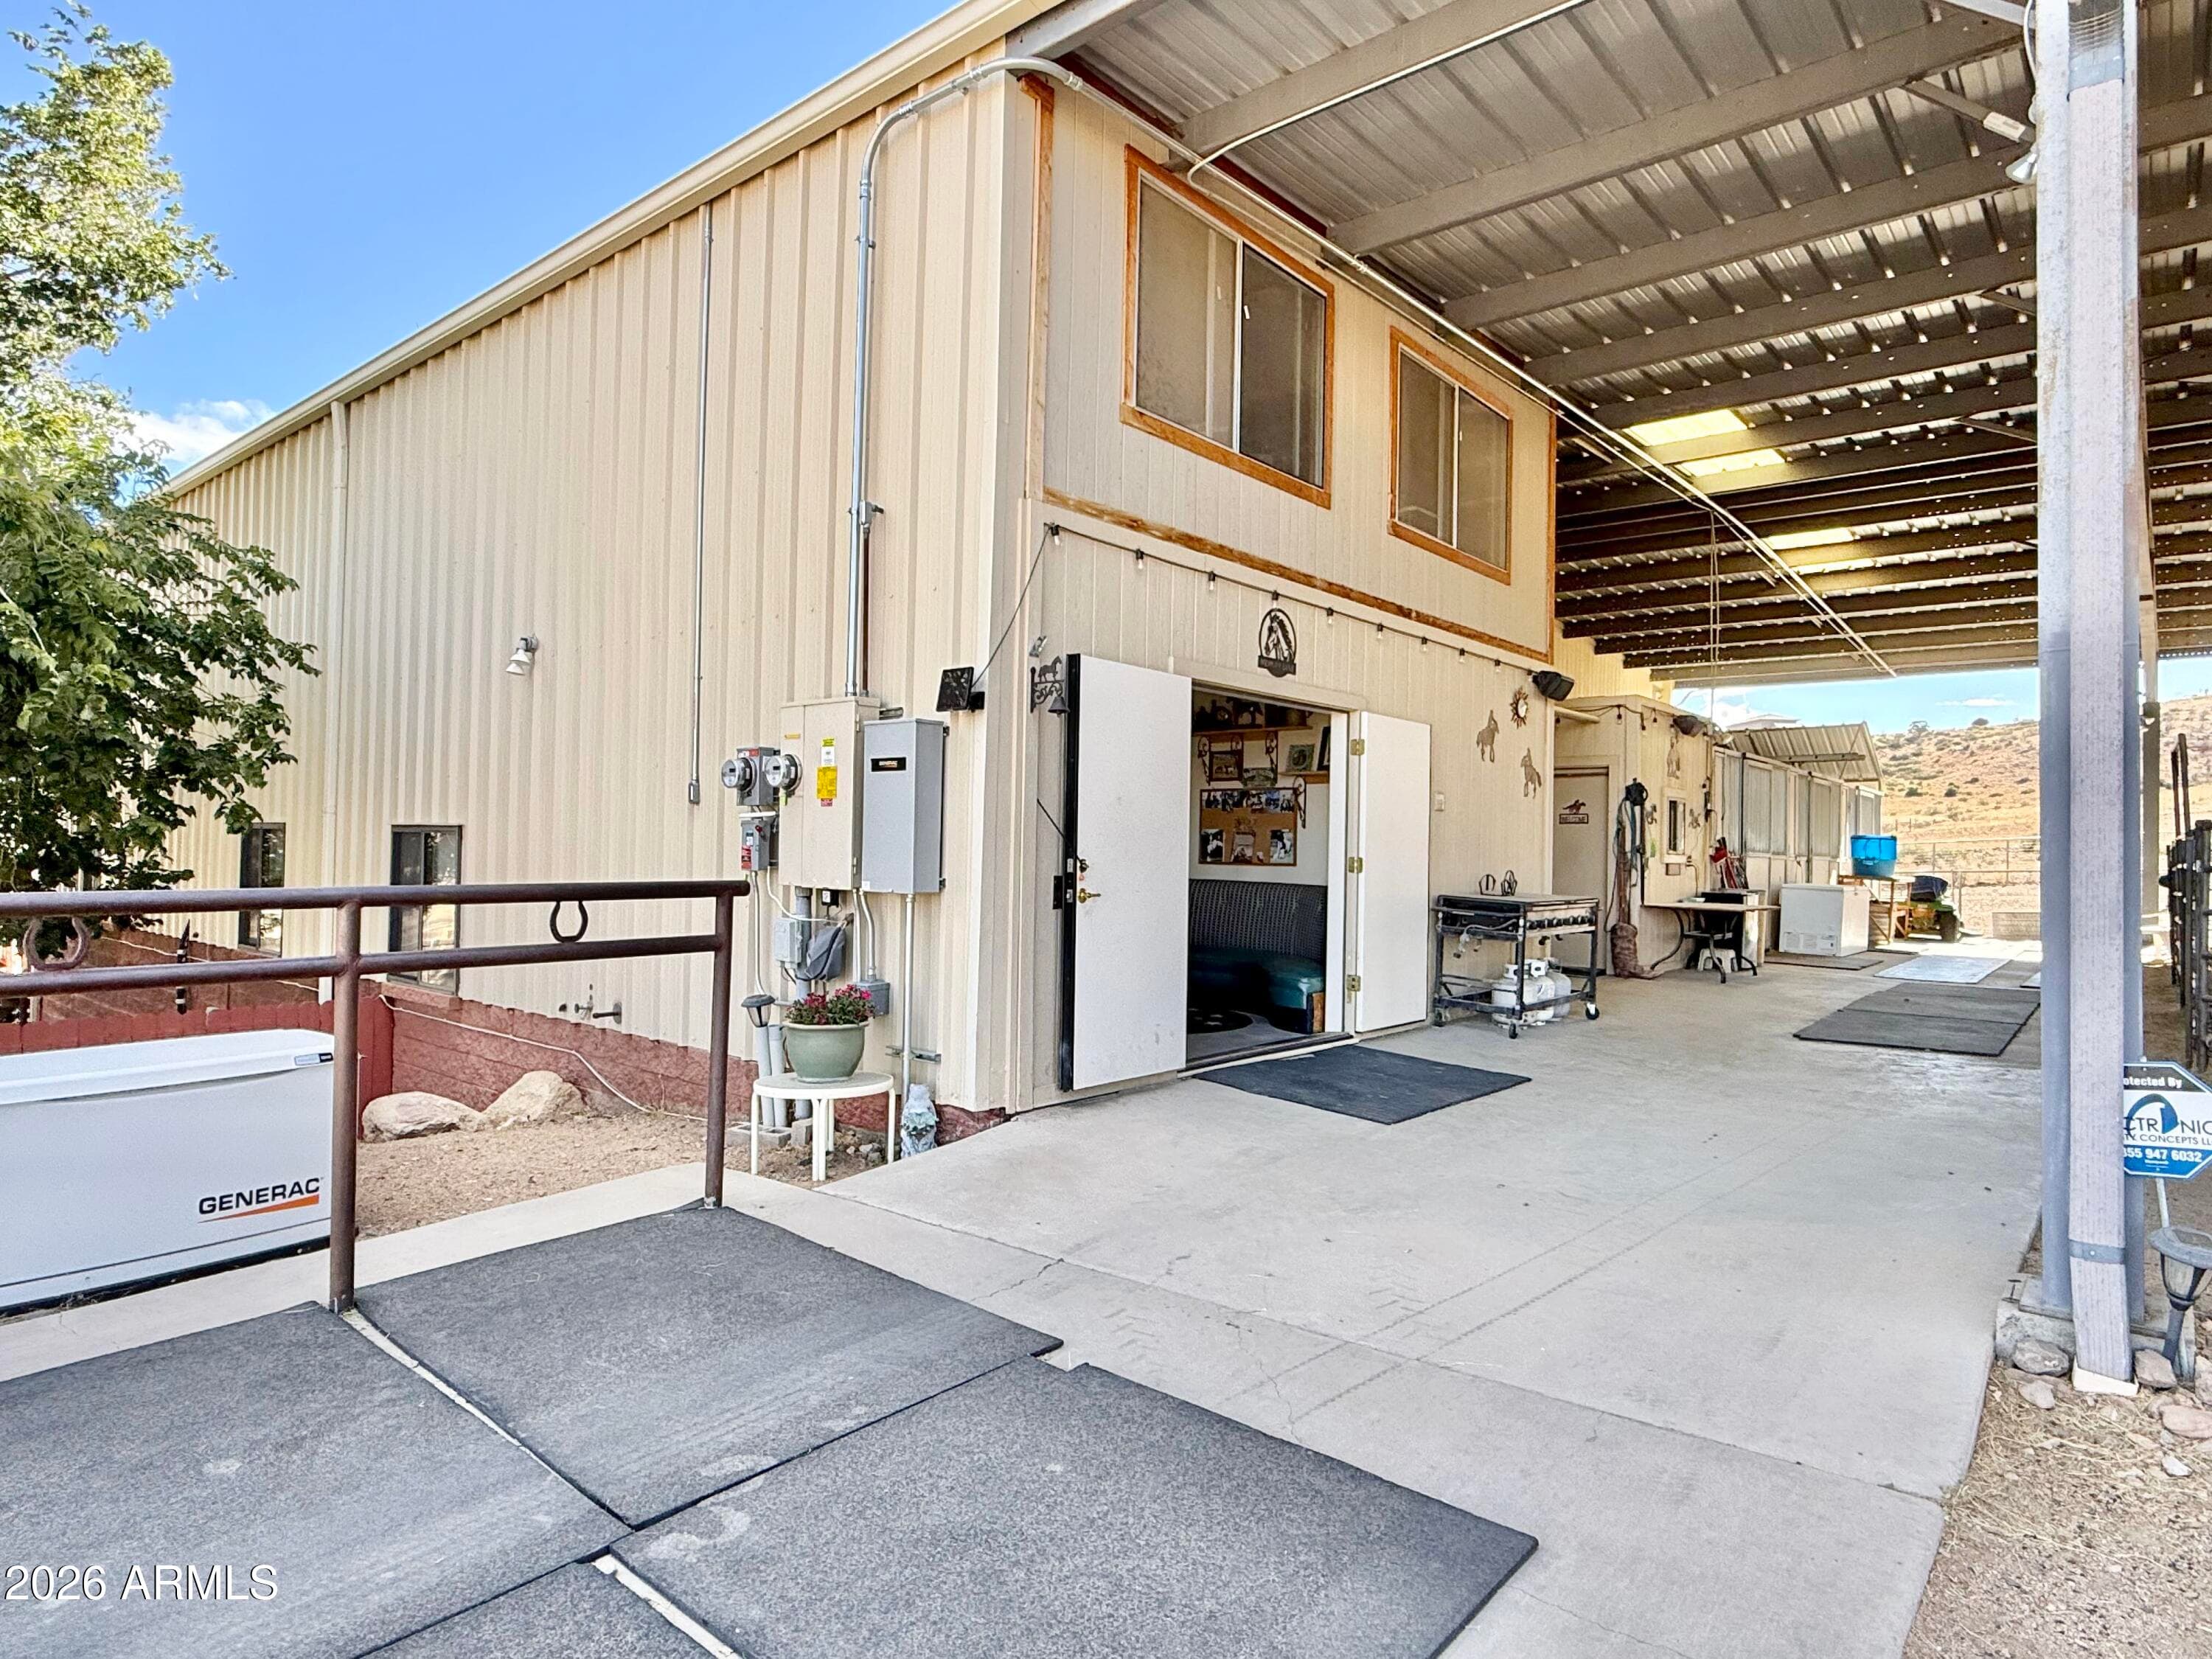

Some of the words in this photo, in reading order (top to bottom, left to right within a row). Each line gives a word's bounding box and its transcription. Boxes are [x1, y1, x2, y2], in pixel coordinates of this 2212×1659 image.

[2123, 1077, 2166, 1087] otected
[2168, 1077, 2183, 1089] By
[2140, 1133, 2199, 1145] CONCEPTS
[2201, 1137, 2212, 1146] LL
[2145, 1148, 2168, 1160] 947
[2171, 1150, 2202, 1163] 6032
[198, 1177, 320, 1215] GENERAC
